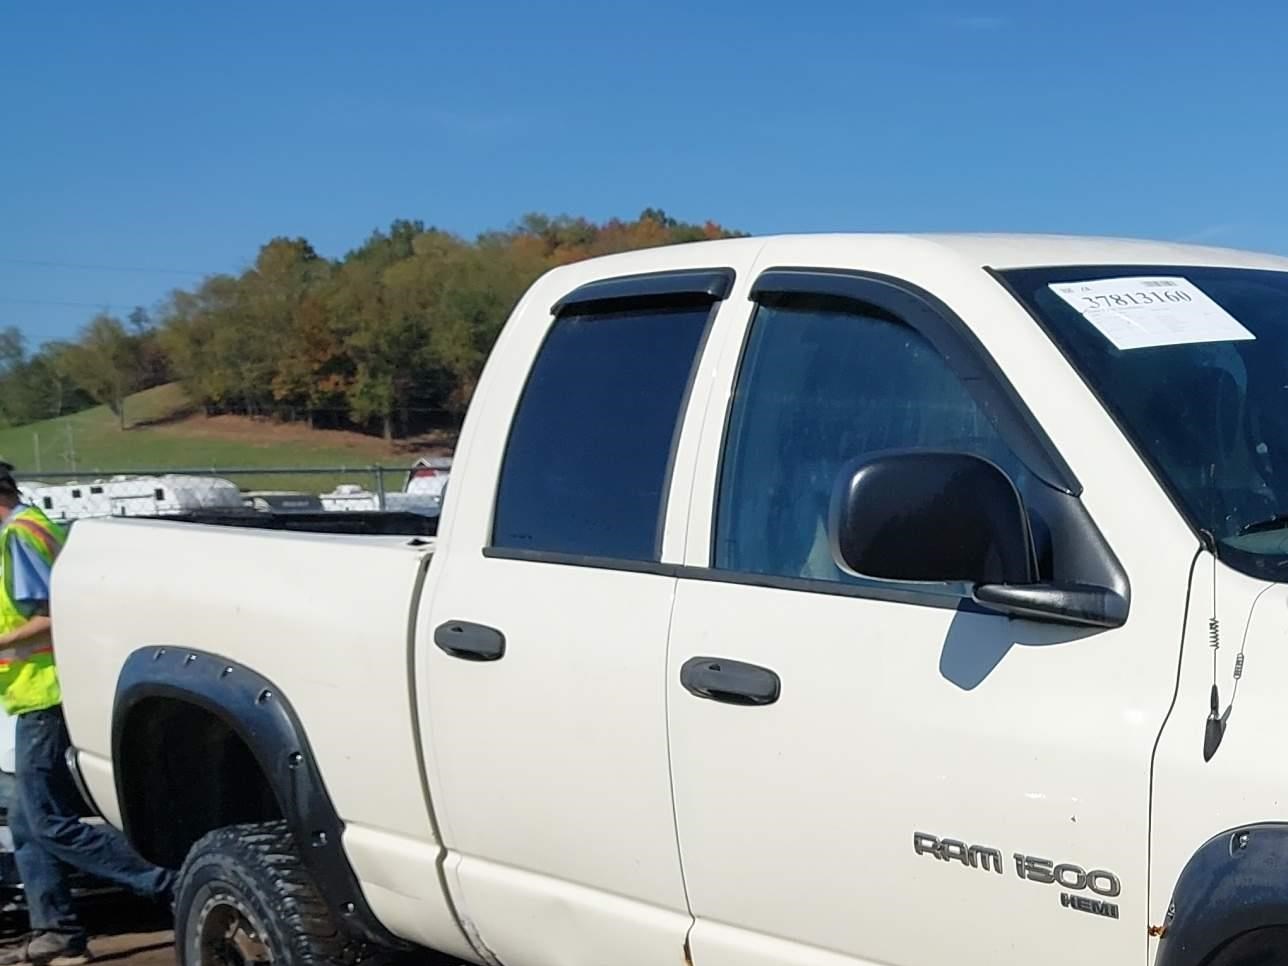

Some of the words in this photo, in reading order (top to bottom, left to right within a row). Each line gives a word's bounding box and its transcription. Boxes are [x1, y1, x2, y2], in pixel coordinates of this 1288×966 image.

[1081, 289, 1193, 310] 37813160
[913, 831, 1003, 874] RAM
[1013, 852, 1121, 898] 1500
[1060, 892, 1119, 920] HEMI
